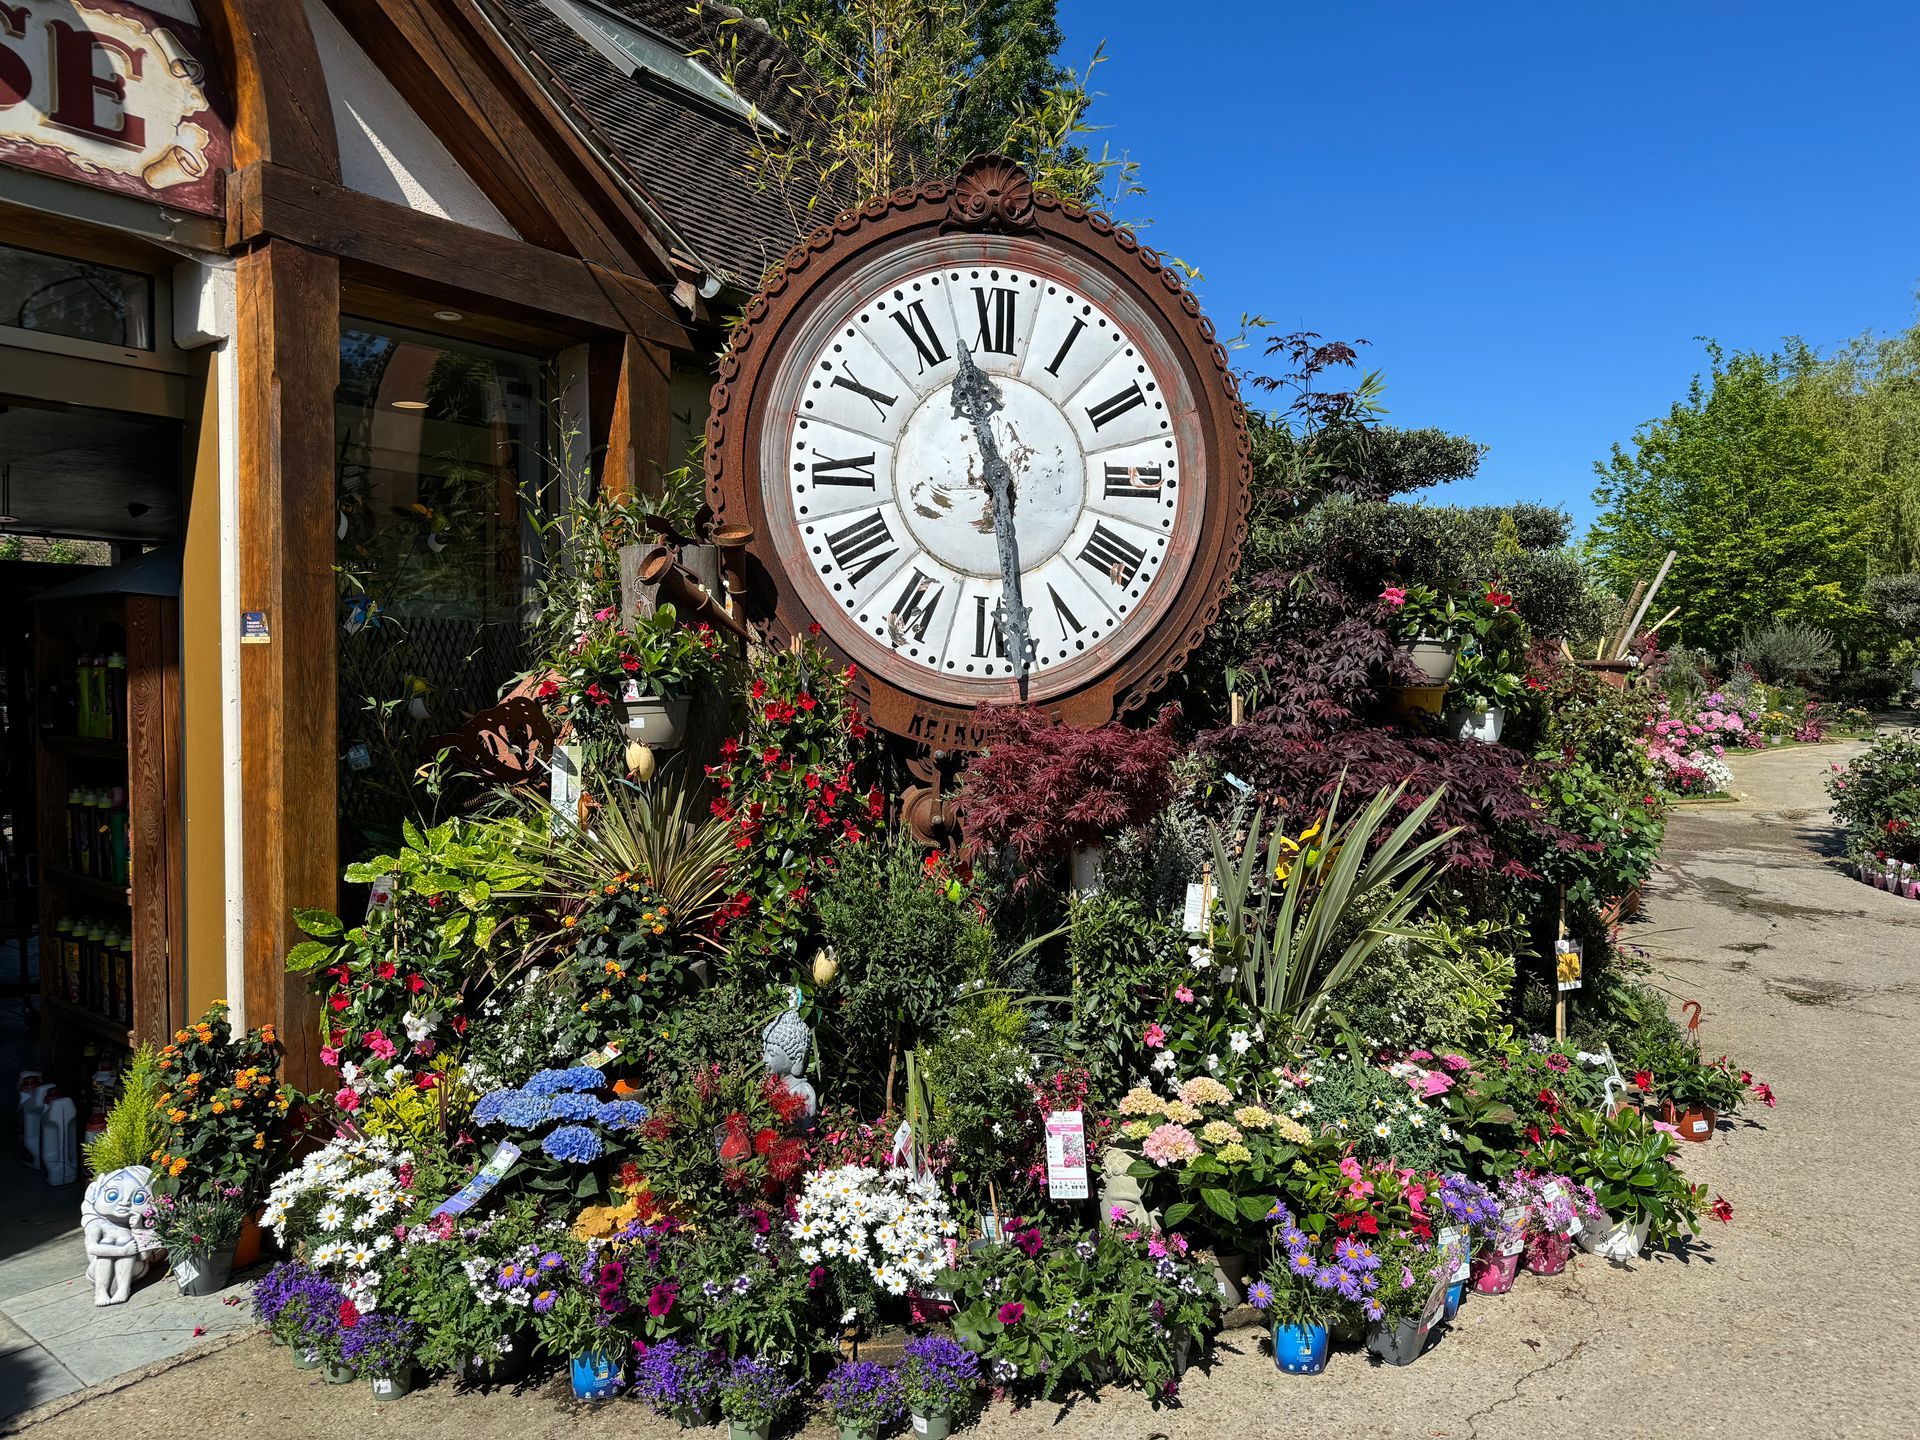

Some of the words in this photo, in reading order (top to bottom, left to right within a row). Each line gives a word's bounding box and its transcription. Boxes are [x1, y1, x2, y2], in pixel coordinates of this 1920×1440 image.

[889, 298, 951, 375] XI
[969, 286, 1019, 357] XII
[1044, 315, 1088, 378] I
[830, 360, 899, 423] X
[1085, 380, 1147, 433] II
[812, 448, 876, 492] IX
[1103, 461, 1162, 503] III
[824, 508, 900, 589] VIII
[1076, 520, 1148, 591] IIII
[1046, 582, 1086, 642] V
